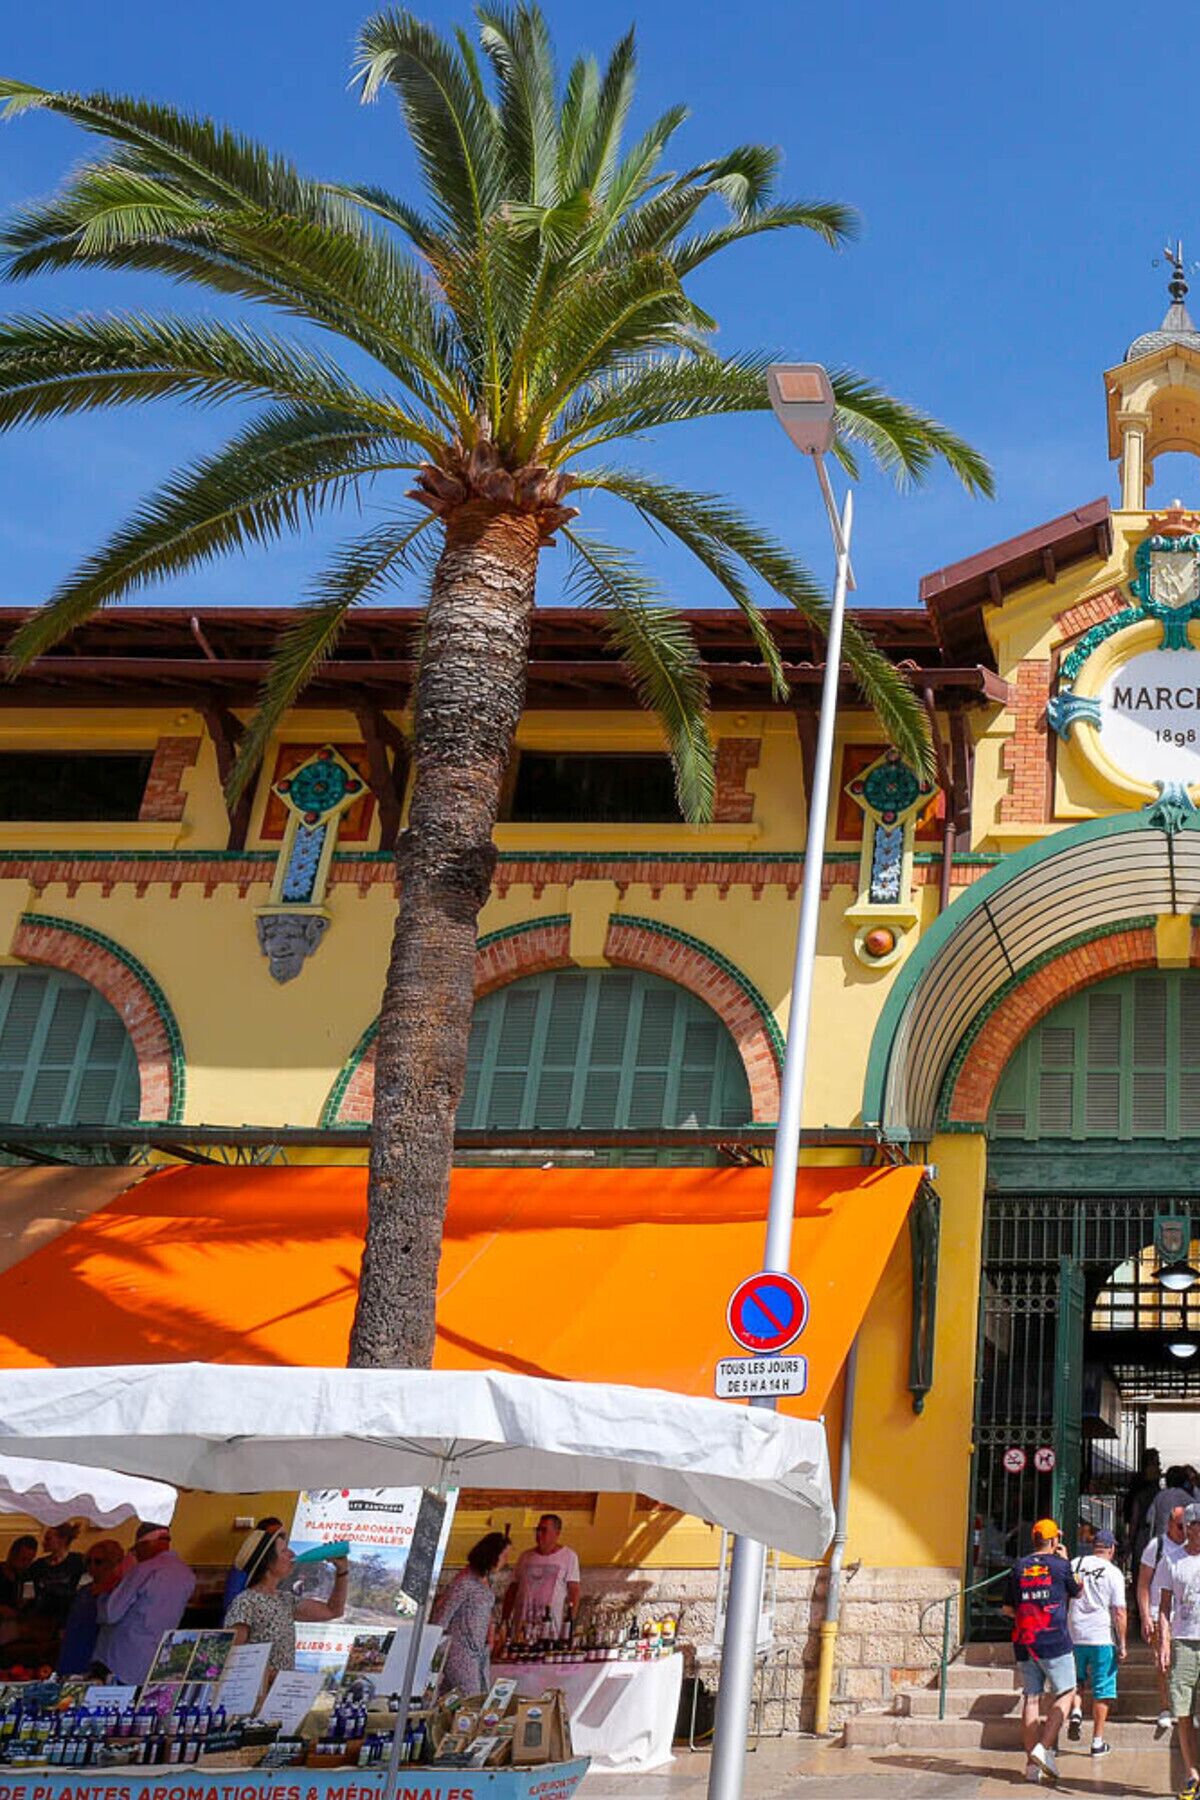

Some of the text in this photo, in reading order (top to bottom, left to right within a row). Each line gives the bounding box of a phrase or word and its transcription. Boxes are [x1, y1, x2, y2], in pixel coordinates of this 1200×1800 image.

[1155, 729, 1196, 748] 1898
[720, 1360, 799, 1375] TOUS LES JOURS
[728, 1380, 740, 1393] DE
[750, 1380, 758, 1391] H
[782, 1378, 789, 1390] H
[305, 1520, 413, 1535] PLANTES AROMATIQ
[296, 1641, 332, 1651] ELIERS
[0, 1782, 474, 1800] DE PLANTES AROMATIQUES & MÉDIINALES
